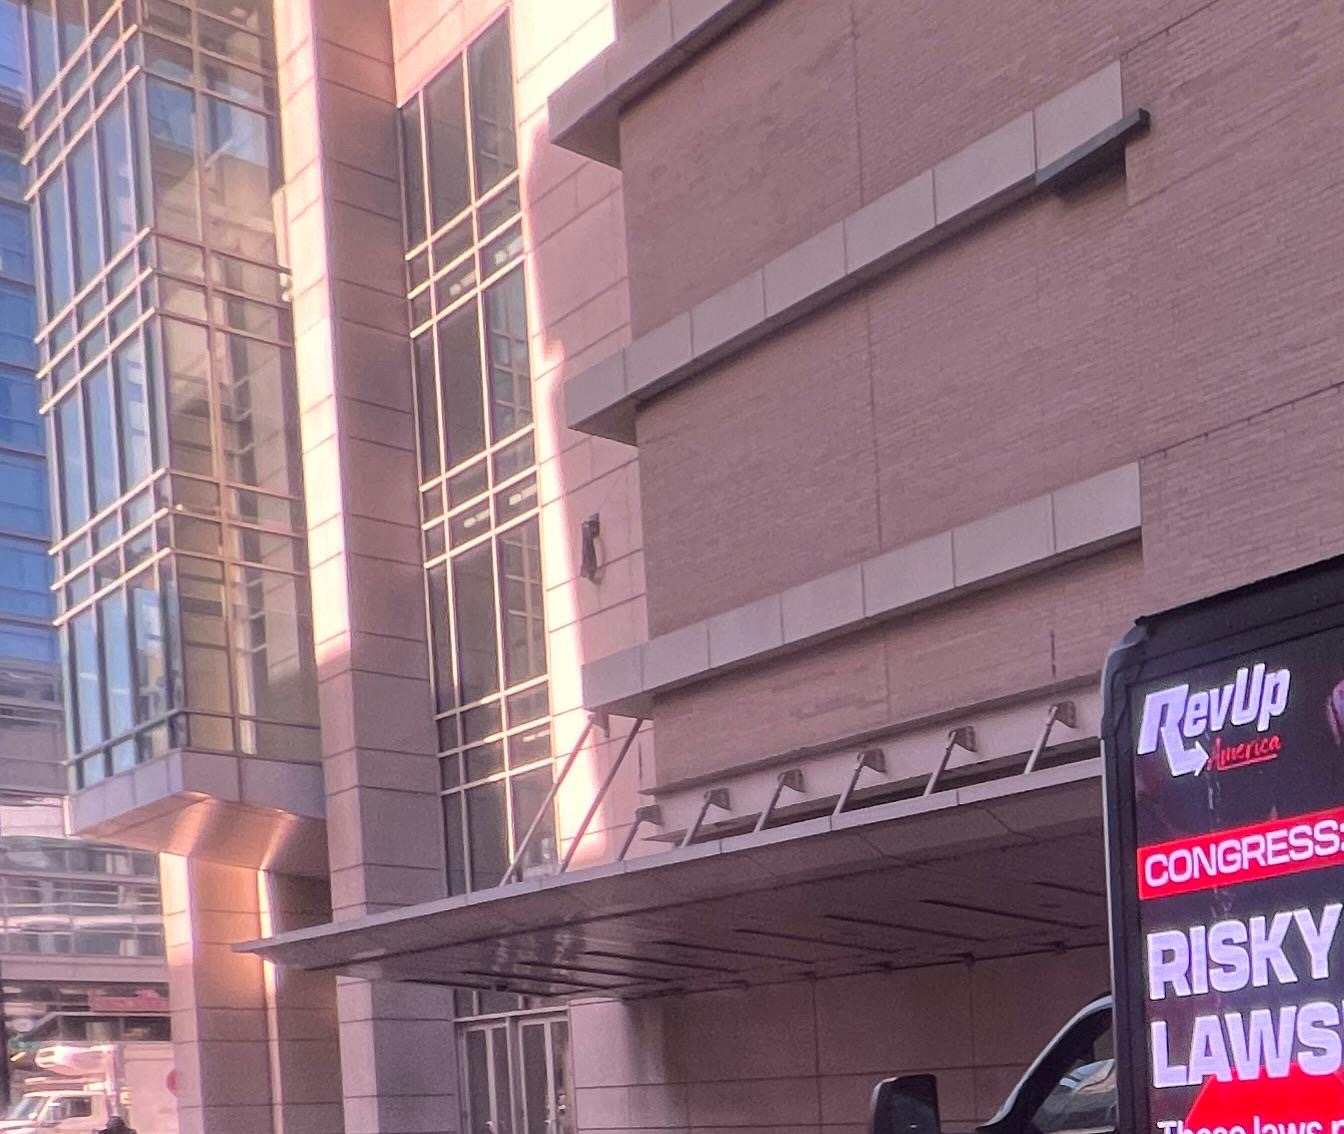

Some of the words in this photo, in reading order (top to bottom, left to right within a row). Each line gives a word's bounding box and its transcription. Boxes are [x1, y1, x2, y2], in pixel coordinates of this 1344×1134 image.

[1137, 663, 1290, 777] RevUp
[1206, 733, 1281, 771] America
[1147, 903, 1343, 999] RISKY
